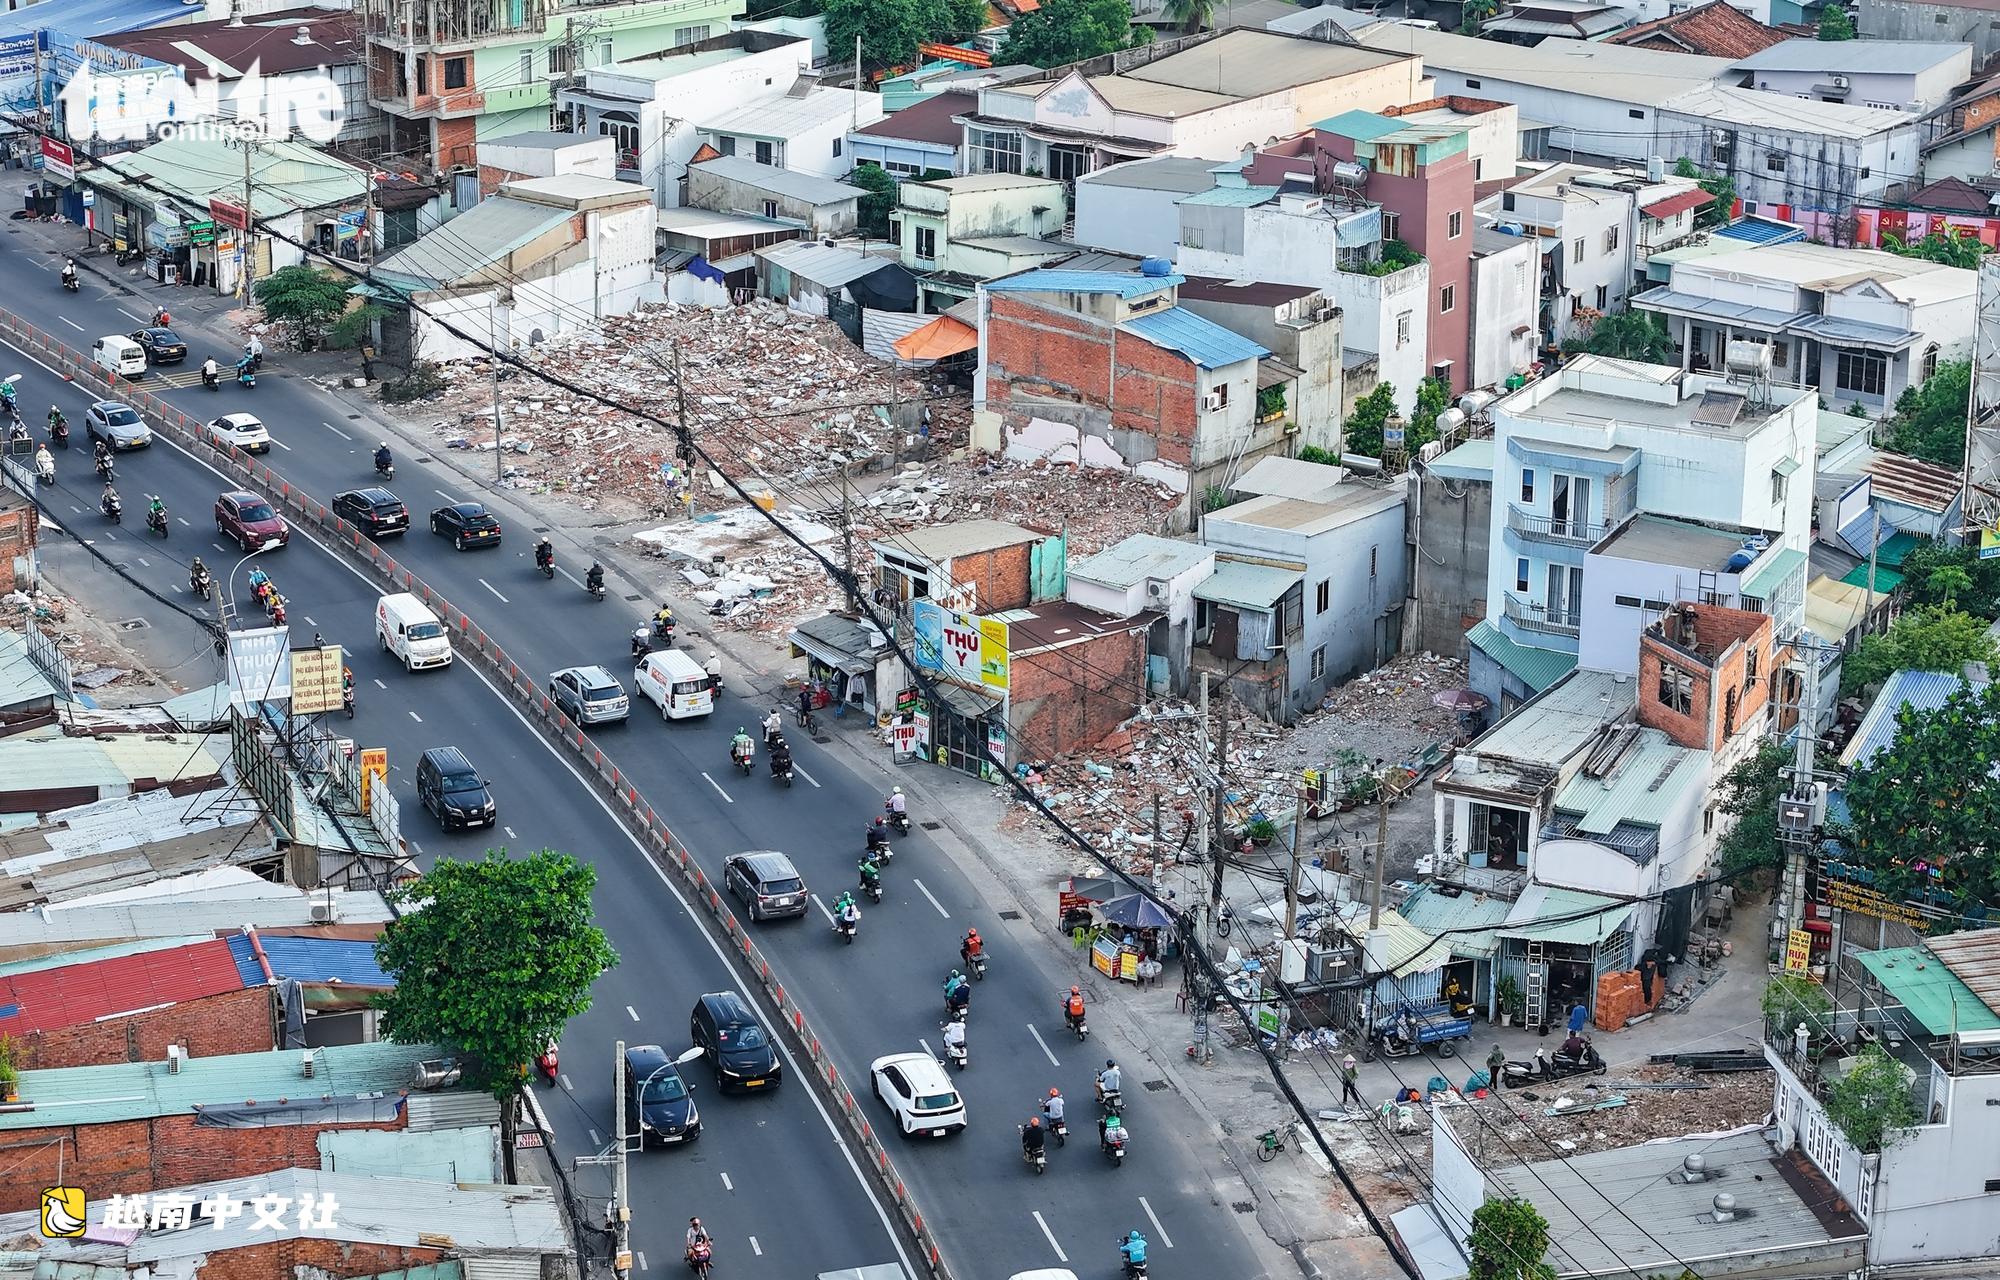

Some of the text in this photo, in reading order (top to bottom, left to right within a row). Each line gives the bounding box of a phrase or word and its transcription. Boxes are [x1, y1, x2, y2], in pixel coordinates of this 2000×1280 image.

[944, 629, 979, 652] THÚ
[956, 650, 967, 667] Y
[915, 715, 929, 729] THÚ
[895, 726, 915, 740] THÚ
[919, 731, 924, 741] Y
[901, 740, 908, 751] Y
[989, 741, 1005, 754] THÚ
[1788, 949, 1806, 961] RỬA
[522, 1133, 538, 1141] NHA
